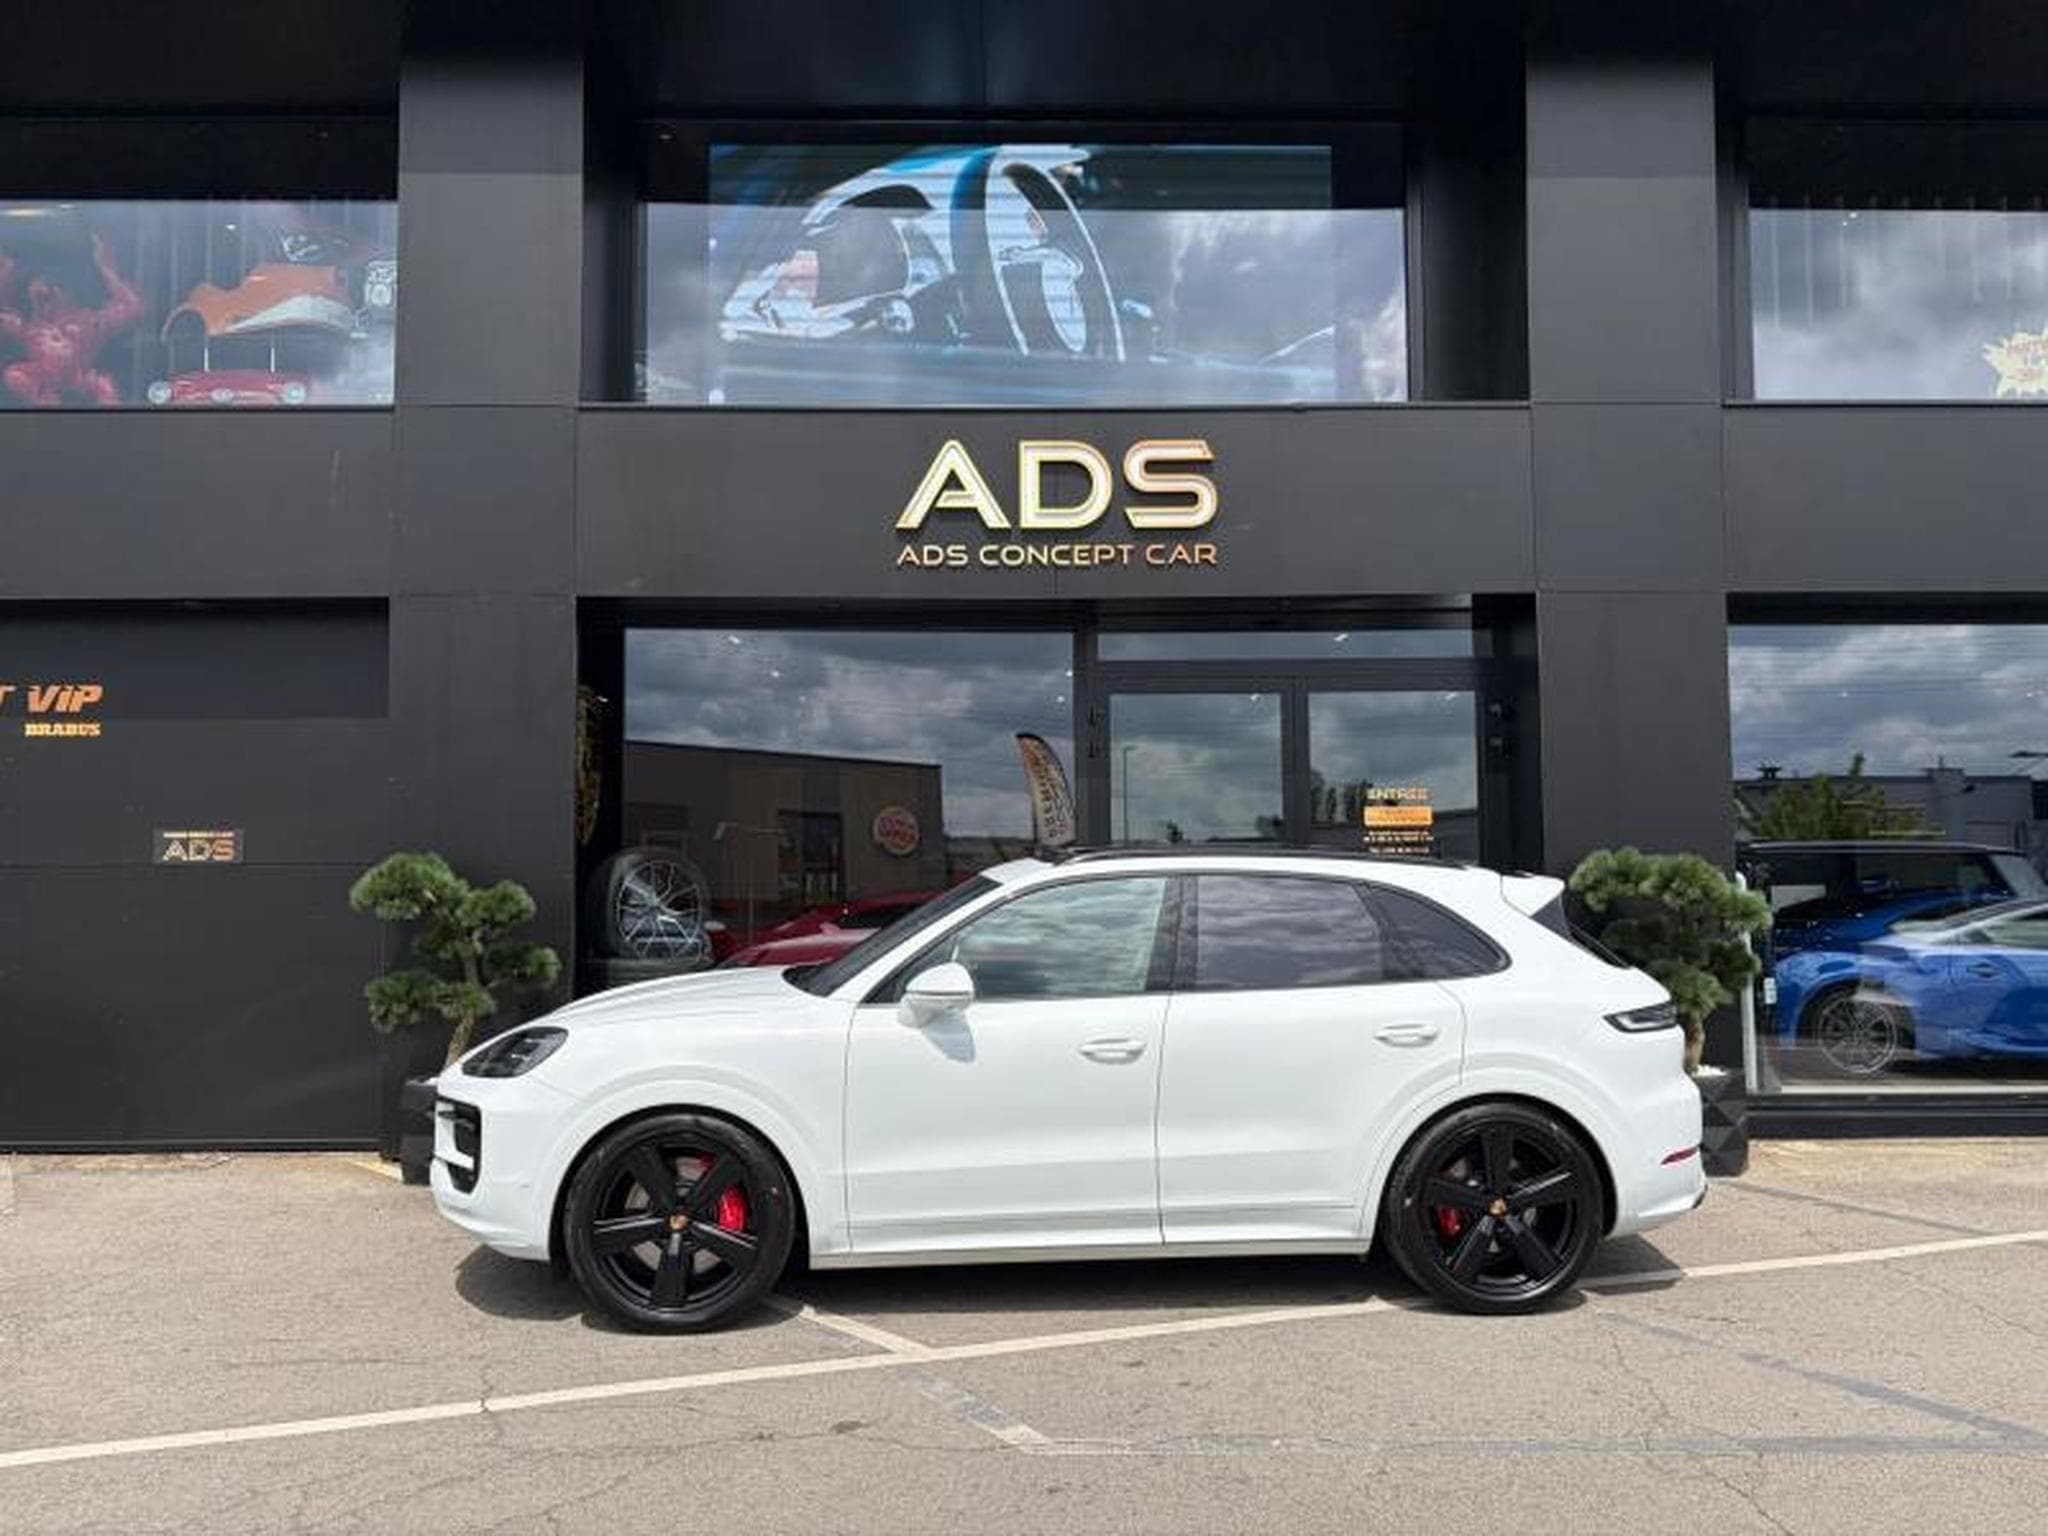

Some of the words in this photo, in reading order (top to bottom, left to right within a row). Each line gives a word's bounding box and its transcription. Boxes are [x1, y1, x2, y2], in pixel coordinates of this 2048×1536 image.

[895, 439, 1218, 529] ADS
[897, 545, 968, 566] ADS
[979, 544, 1134, 566] CONCEPT
[1146, 543, 1218, 565] CAR
[163, 839, 235, 861] ADS
